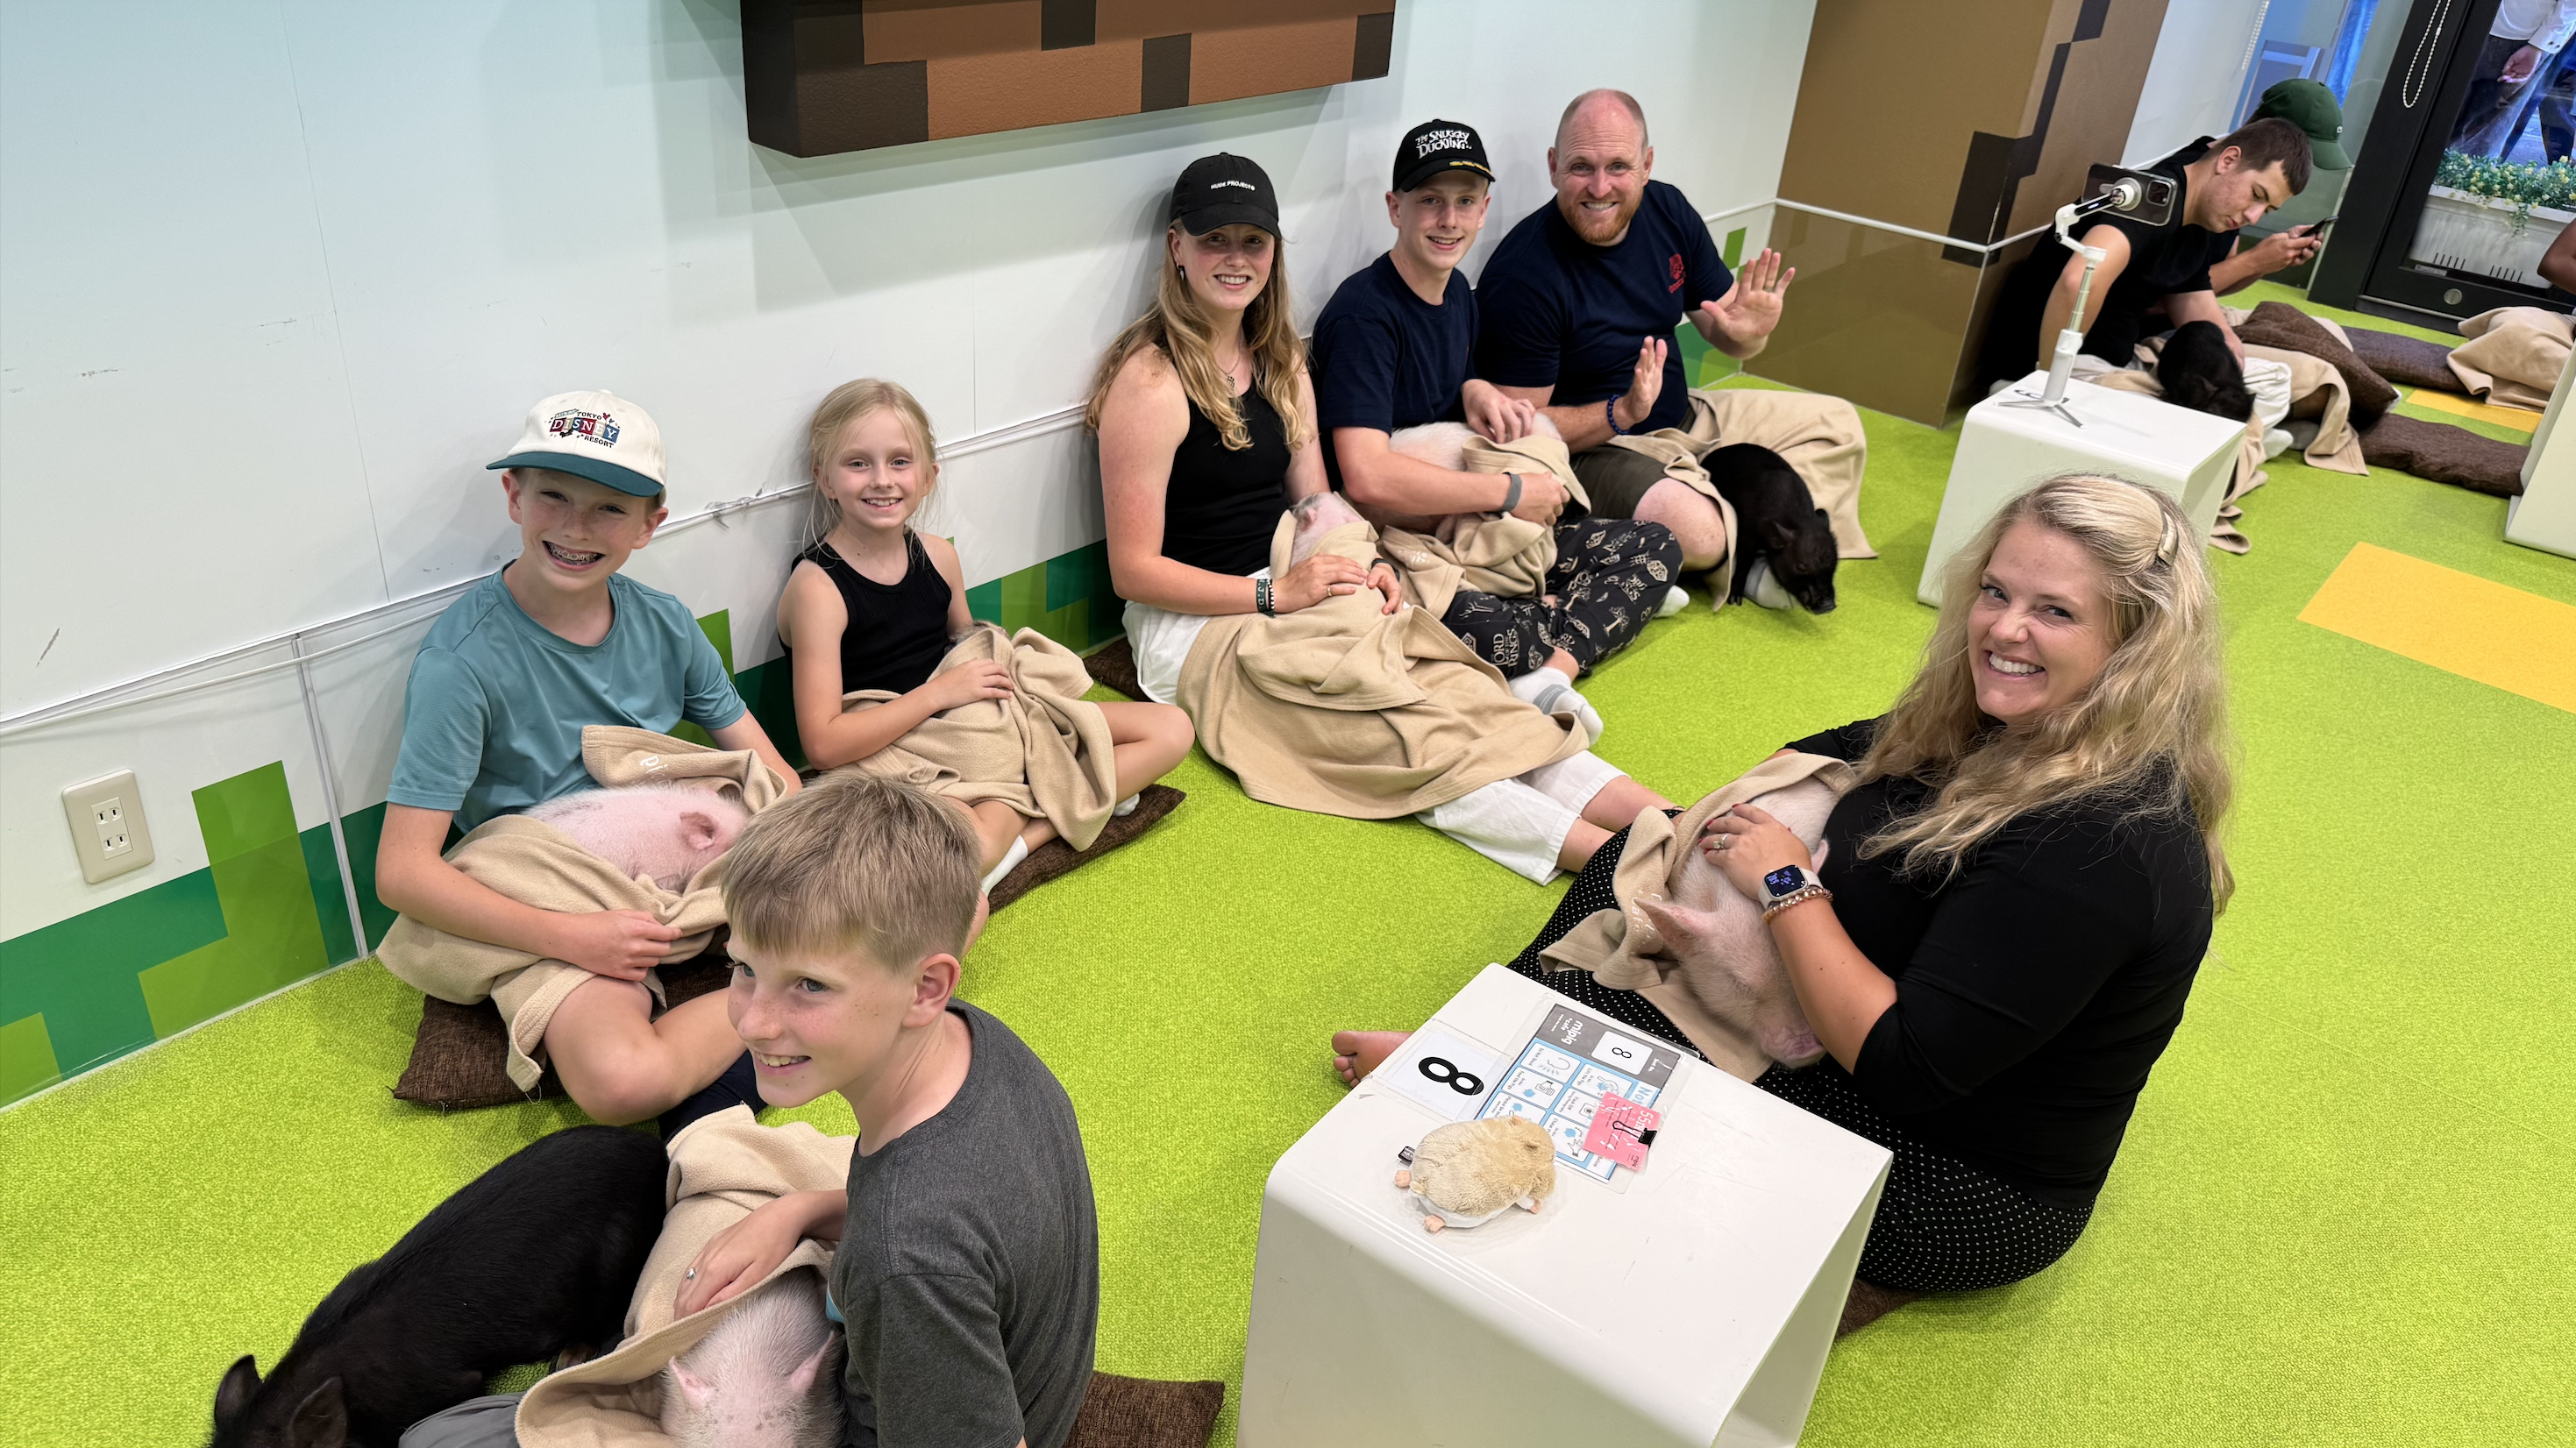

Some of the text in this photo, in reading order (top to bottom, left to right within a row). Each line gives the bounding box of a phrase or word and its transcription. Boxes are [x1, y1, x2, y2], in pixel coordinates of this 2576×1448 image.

[577, 411, 602, 420] TOKYO
[551, 418, 618, 440] DISNEY
[584, 435, 615, 449] RESORT
[1491, 633, 1508, 666] LORD
[1506, 628, 1520, 667] RINGS
[1561, 1020, 1583, 1045] mipig
[1612, 1047, 1632, 1059] 8
[1418, 1056, 1484, 1096] 8
